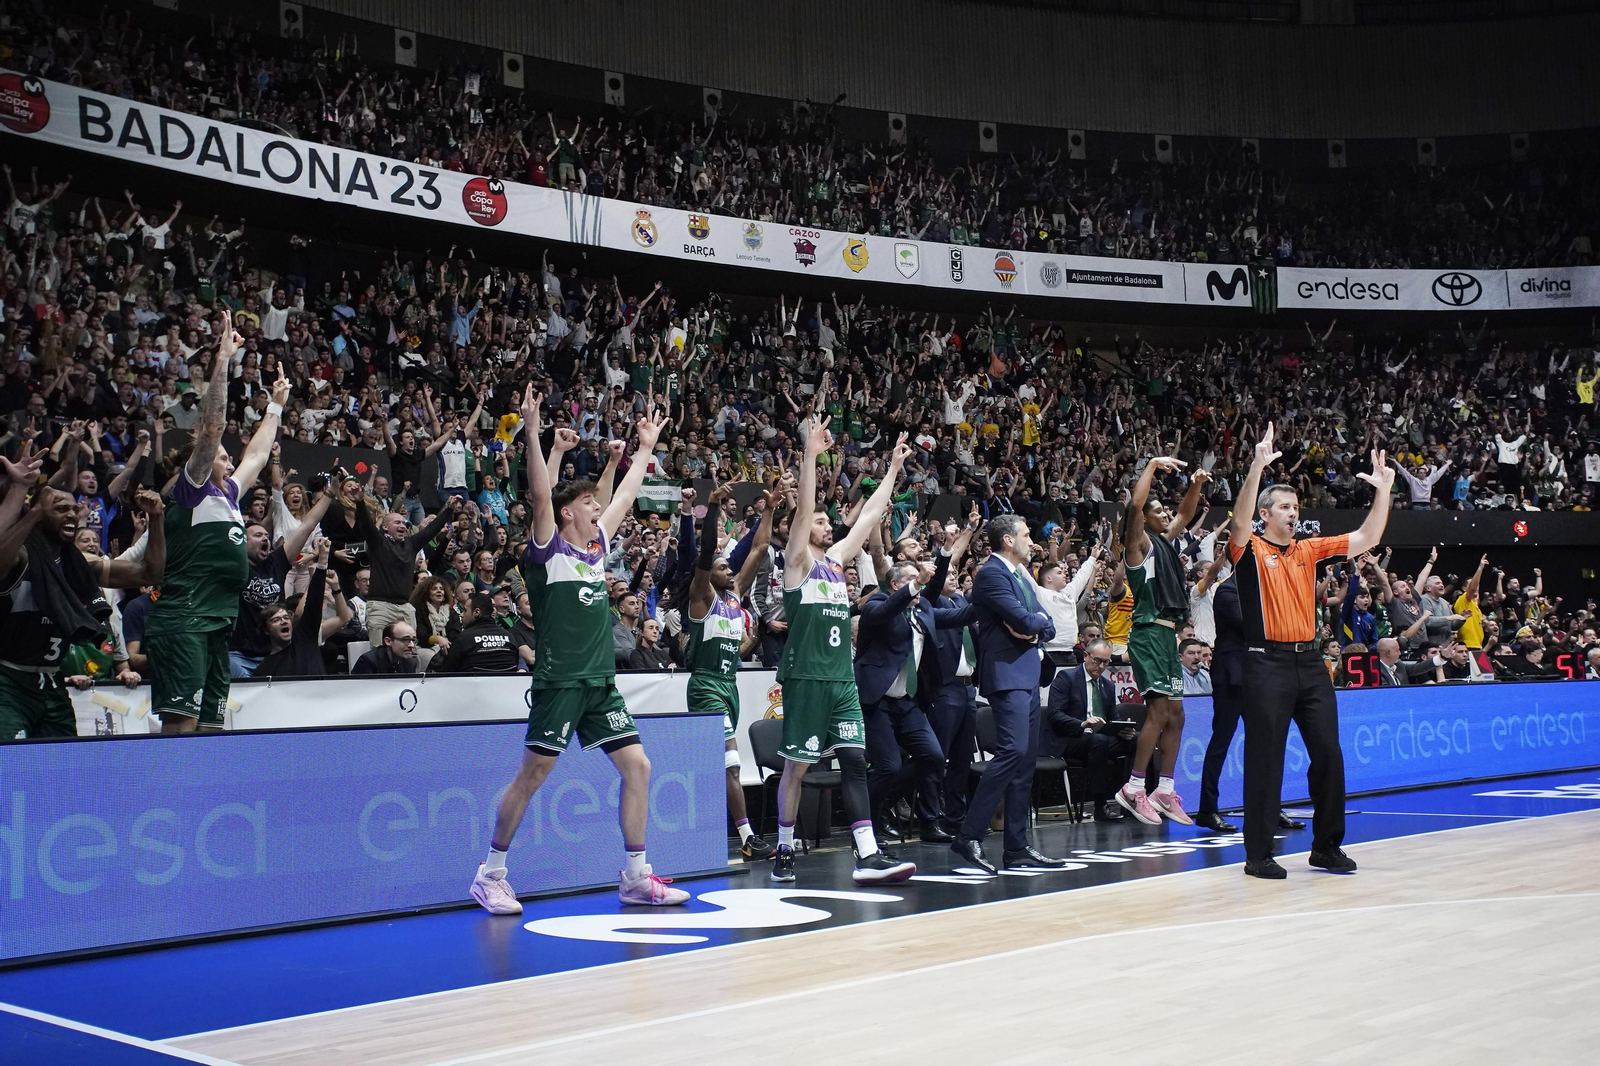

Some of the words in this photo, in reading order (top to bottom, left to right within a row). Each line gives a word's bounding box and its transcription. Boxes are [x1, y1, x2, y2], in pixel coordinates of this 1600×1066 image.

[14, 106, 34, 119] Rey
[470, 194, 493, 205] Copa
[481, 204, 497, 215] Rey
[788, 228, 821, 239] CAZOO
[683, 243, 716, 257] BARÇA
[735, 253, 753, 261] Lenovo
[1071, 272, 1113, 283] Ajuntament
[1114, 275, 1123, 283] de
[1124, 275, 1157, 285] Badalona
[1520, 276, 1572, 293] divina
[1297, 277, 1399, 301] endesa
[474, 635, 510, 643] DOUBLE
[829, 625, 841, 647] 8
[43, 637, 62, 661] 3
[1353, 708, 1471, 765] endesa
[1490, 702, 1587, 750] endesa
